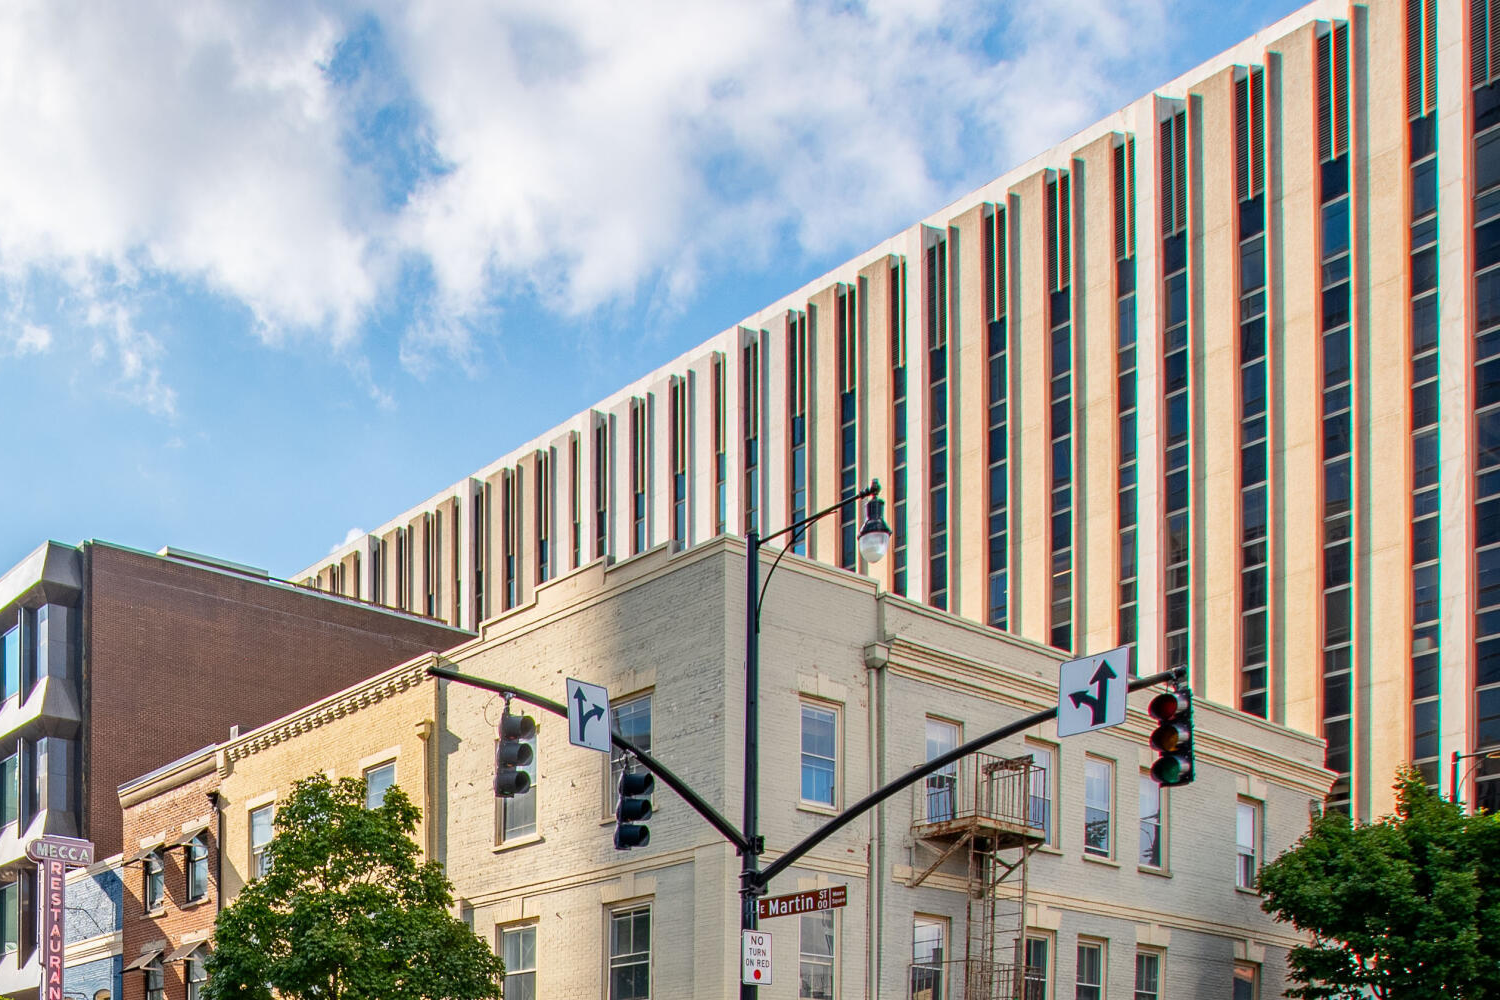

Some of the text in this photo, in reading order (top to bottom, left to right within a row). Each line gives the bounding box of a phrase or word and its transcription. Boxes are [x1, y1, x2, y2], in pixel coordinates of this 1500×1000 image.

[36, 842, 91, 862] MECCA
[819, 890, 828, 899] ST
[760, 894, 814, 916] E Martin
[750, 935, 764, 946] NO
[748, 947, 767, 957] TURN
[745, 958, 770, 968] ON RED
